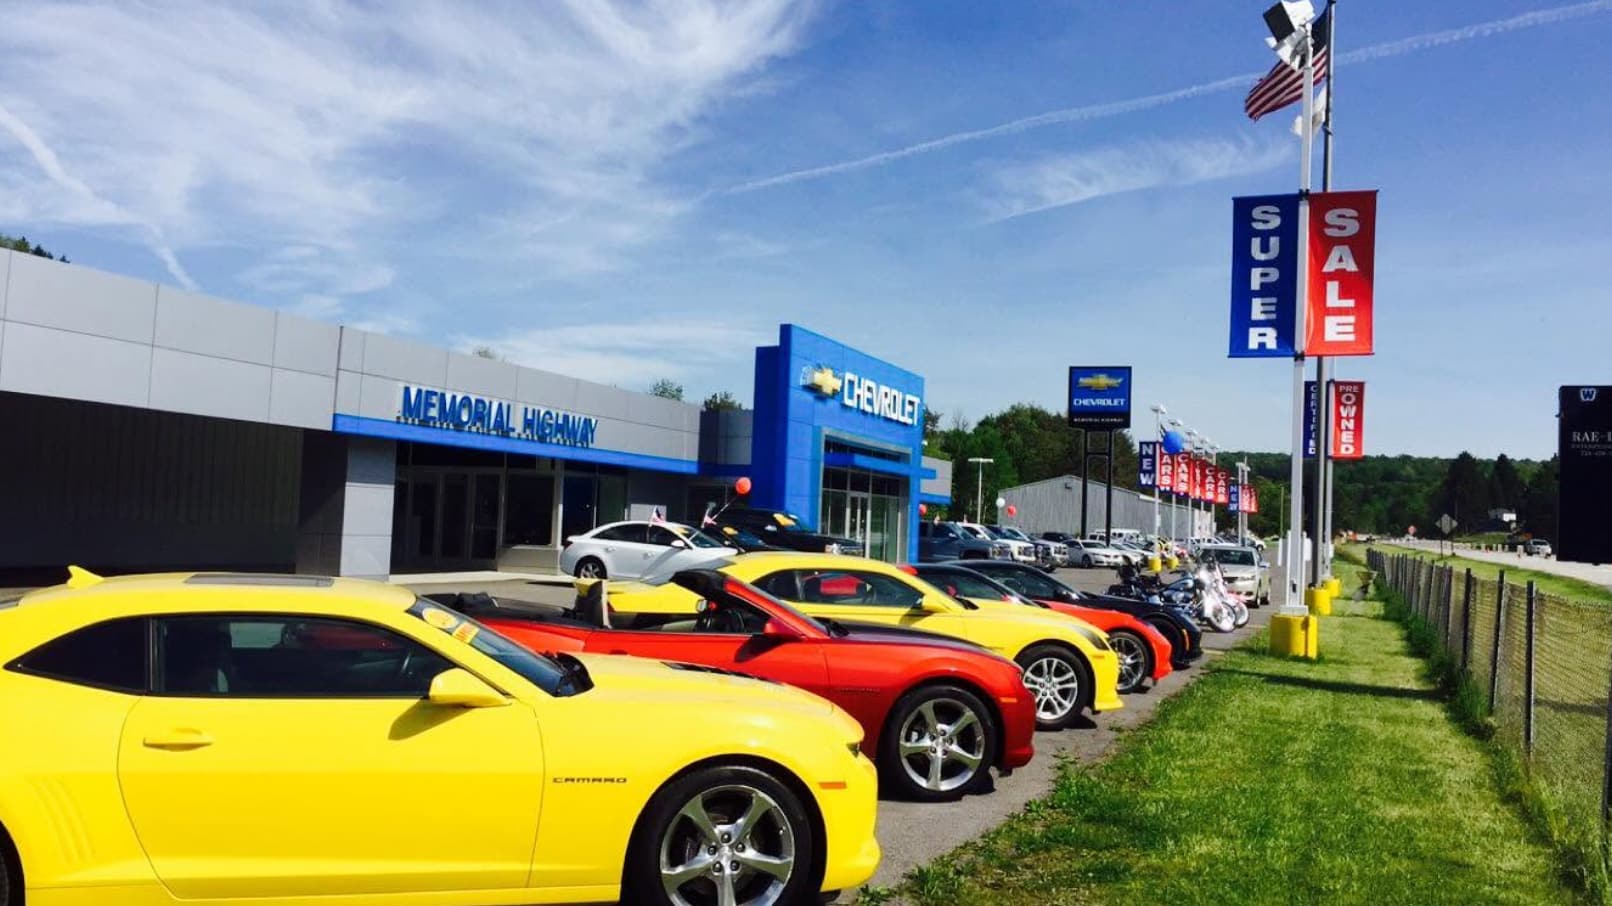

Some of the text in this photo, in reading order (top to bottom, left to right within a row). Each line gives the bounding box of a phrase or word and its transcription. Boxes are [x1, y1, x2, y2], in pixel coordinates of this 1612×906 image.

[1248, 205, 1281, 349] SUPER
[1322, 208, 1360, 342] SALE
[843, 371, 920, 426] CHEVROLET
[1073, 398, 1126, 407] CHEVROLET
[1339, 385, 1359, 393] PRE
[403, 385, 598, 445] MEMORIAL HIGHWAY
[1340, 393, 1357, 455] OWNED
[1140, 443, 1155, 486] NEW
[1161, 454, 1173, 485] ARS
[1178, 453, 1189, 491] CARS
[1205, 467, 1215, 499] CARS
[1229, 485, 1238, 510] NEW
